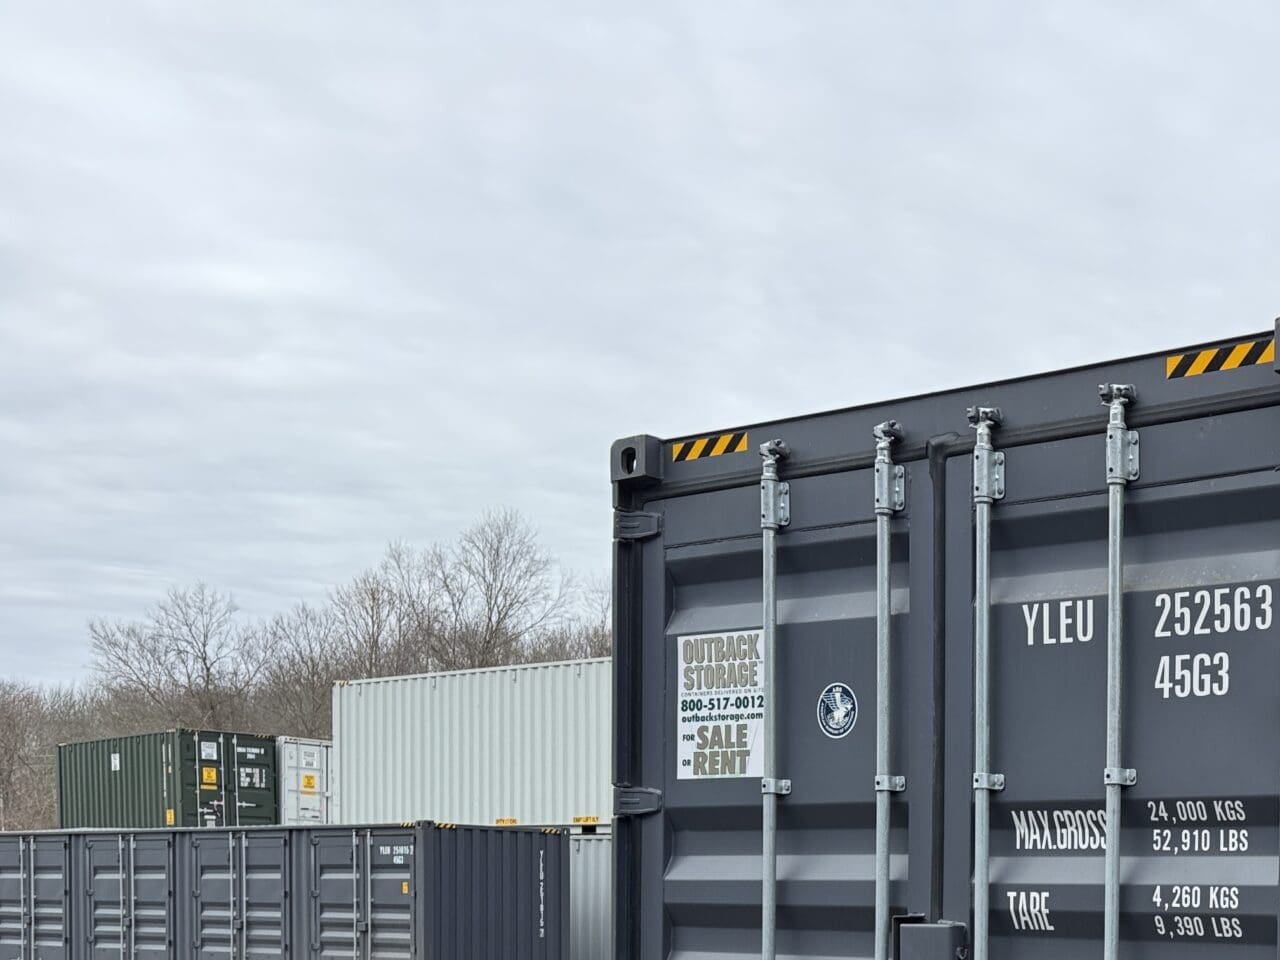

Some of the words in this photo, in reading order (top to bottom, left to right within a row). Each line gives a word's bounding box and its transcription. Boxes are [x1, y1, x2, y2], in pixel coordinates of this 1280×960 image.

[1022, 599, 1094, 646] YLEU
[1154, 584, 1273, 638] 252563
[683, 634, 760, 664] OUTBACK
[683, 661, 758, 691] STORAGE
[1154, 652, 1230, 699] 45G3
[681, 695, 764, 712] 800-517-0012
[682, 712, 763, 723] outbackstorage.com
[682, 734, 695, 742] FOR
[697, 724, 747, 750] SALE
[693, 750, 750, 775] RENT
[1148, 801, 1207, 824] 24,000
[1214, 801, 1246, 821] KGS
[1011, 809, 1106, 849] MAX.GROSS
[1152, 829, 1210, 854] 52,910
[1219, 829, 1249, 851] LBS
[1152, 886, 1200, 911] 4,260
[1209, 886, 1239, 909] KGS
[1007, 892, 1054, 931] TARE
[1154, 915, 1203, 939] 9,390
[1211, 917, 1242, 938] LBS
